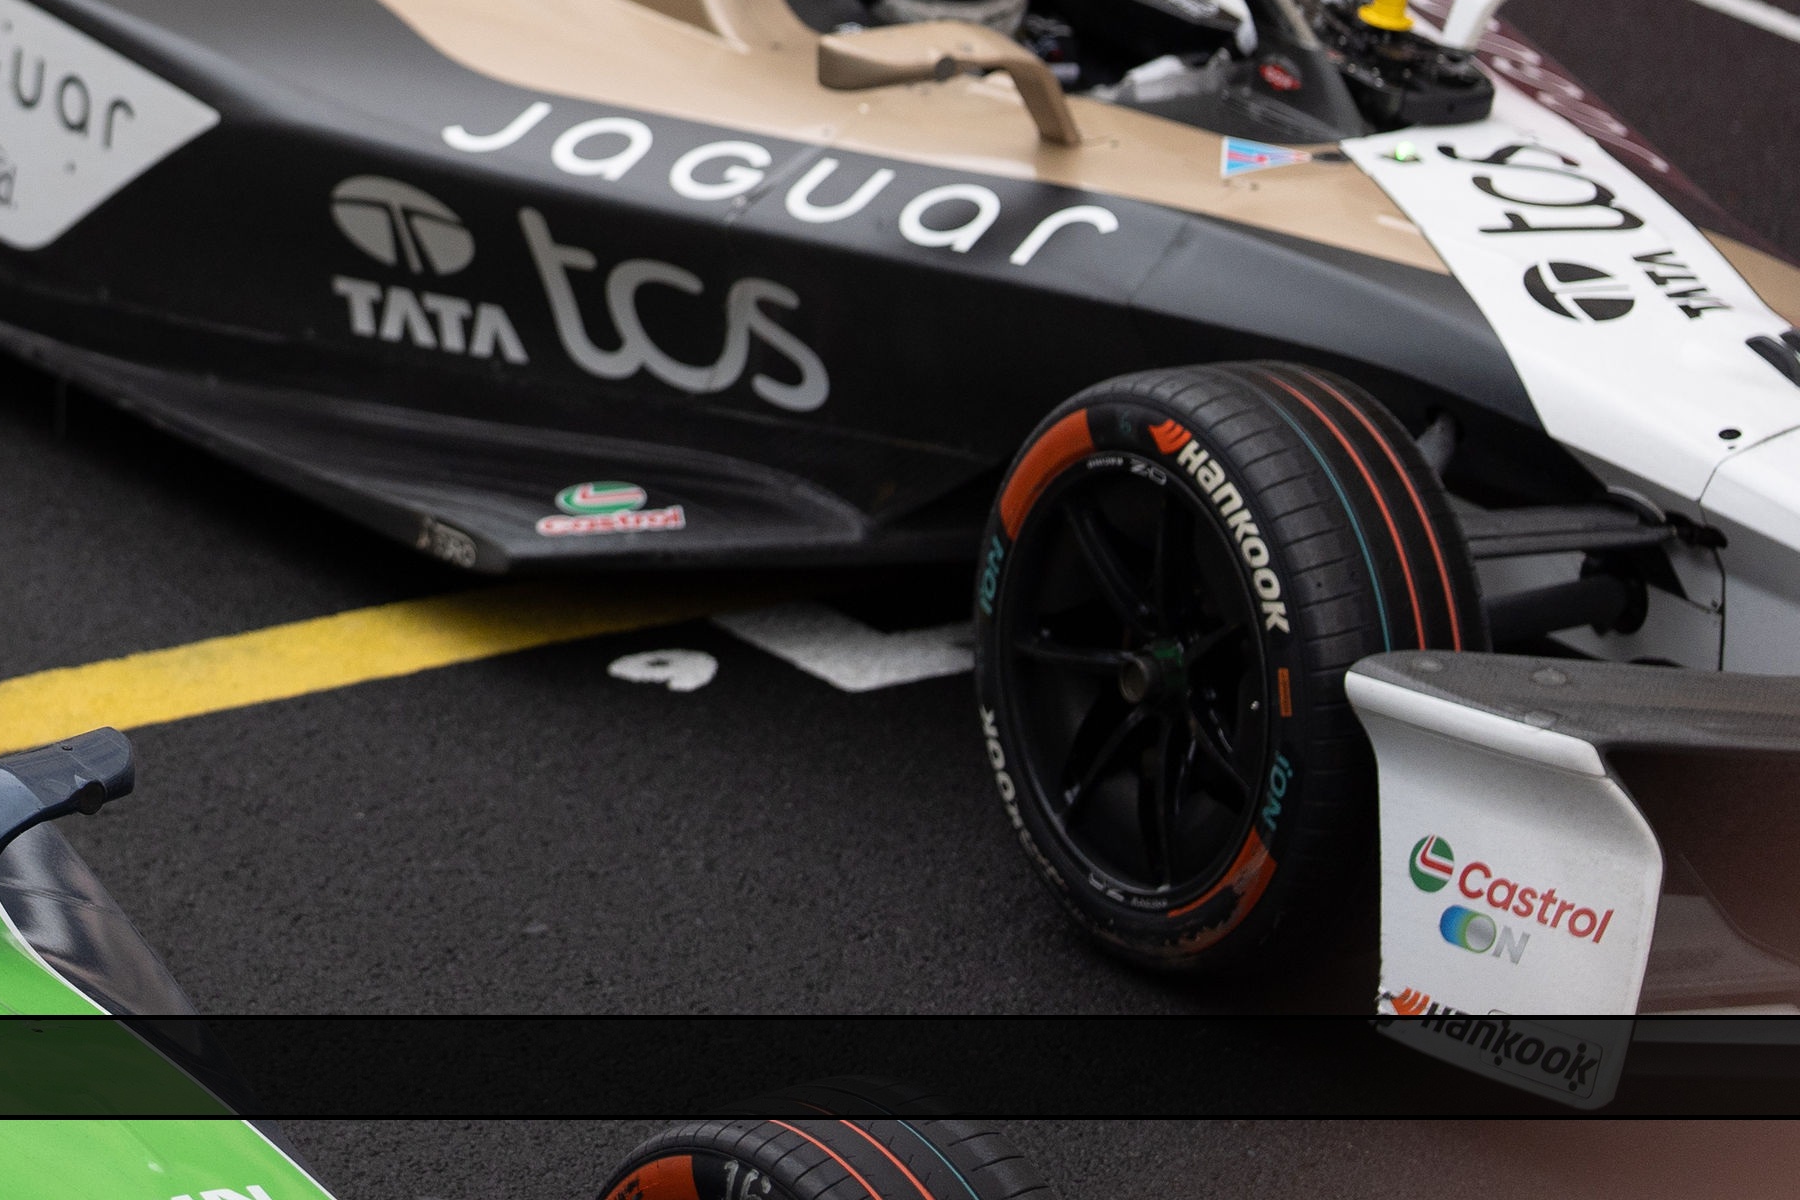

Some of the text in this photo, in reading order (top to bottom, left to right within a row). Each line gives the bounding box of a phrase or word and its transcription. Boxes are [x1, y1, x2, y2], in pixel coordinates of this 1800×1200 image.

[332, 274, 529, 367] TATA
[518, 206, 831, 412] tcs
[1458, 861, 1614, 944] Castrol
